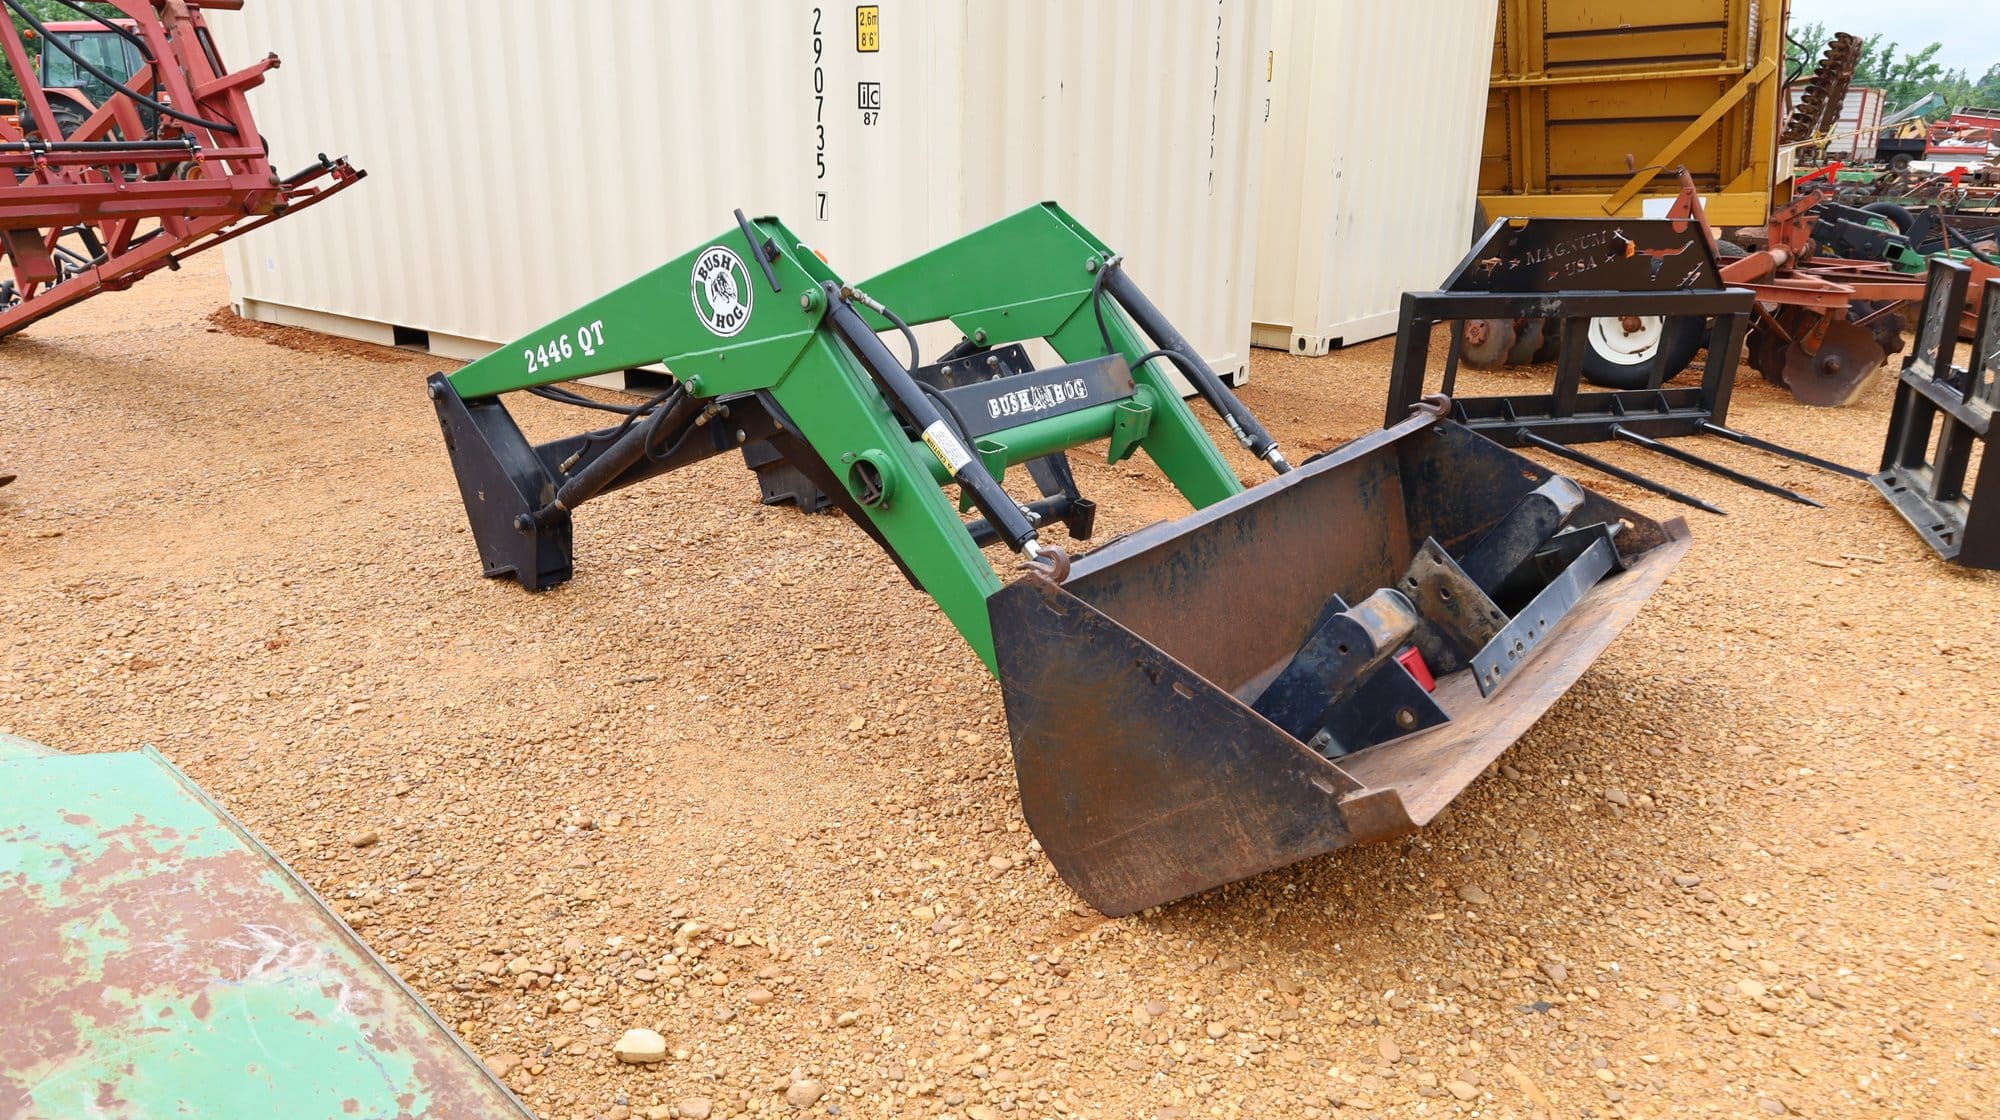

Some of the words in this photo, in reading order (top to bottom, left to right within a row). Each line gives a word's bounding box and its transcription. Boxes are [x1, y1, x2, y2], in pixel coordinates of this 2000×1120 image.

[813, 7, 826, 180] 290735
[863, 111, 879, 126] 87
[817, 192, 826, 219] 7
[1526, 230, 1607, 266] MAGNUM
[697, 253, 732, 281] BUSH
[1565, 255, 1598, 276] USA
[716, 305, 744, 329] HOG
[524, 334, 573, 374] 2446
[577, 319, 605, 357] QT
[988, 389, 1033, 419] BUSH
[1053, 378, 1088, 405] HOG
